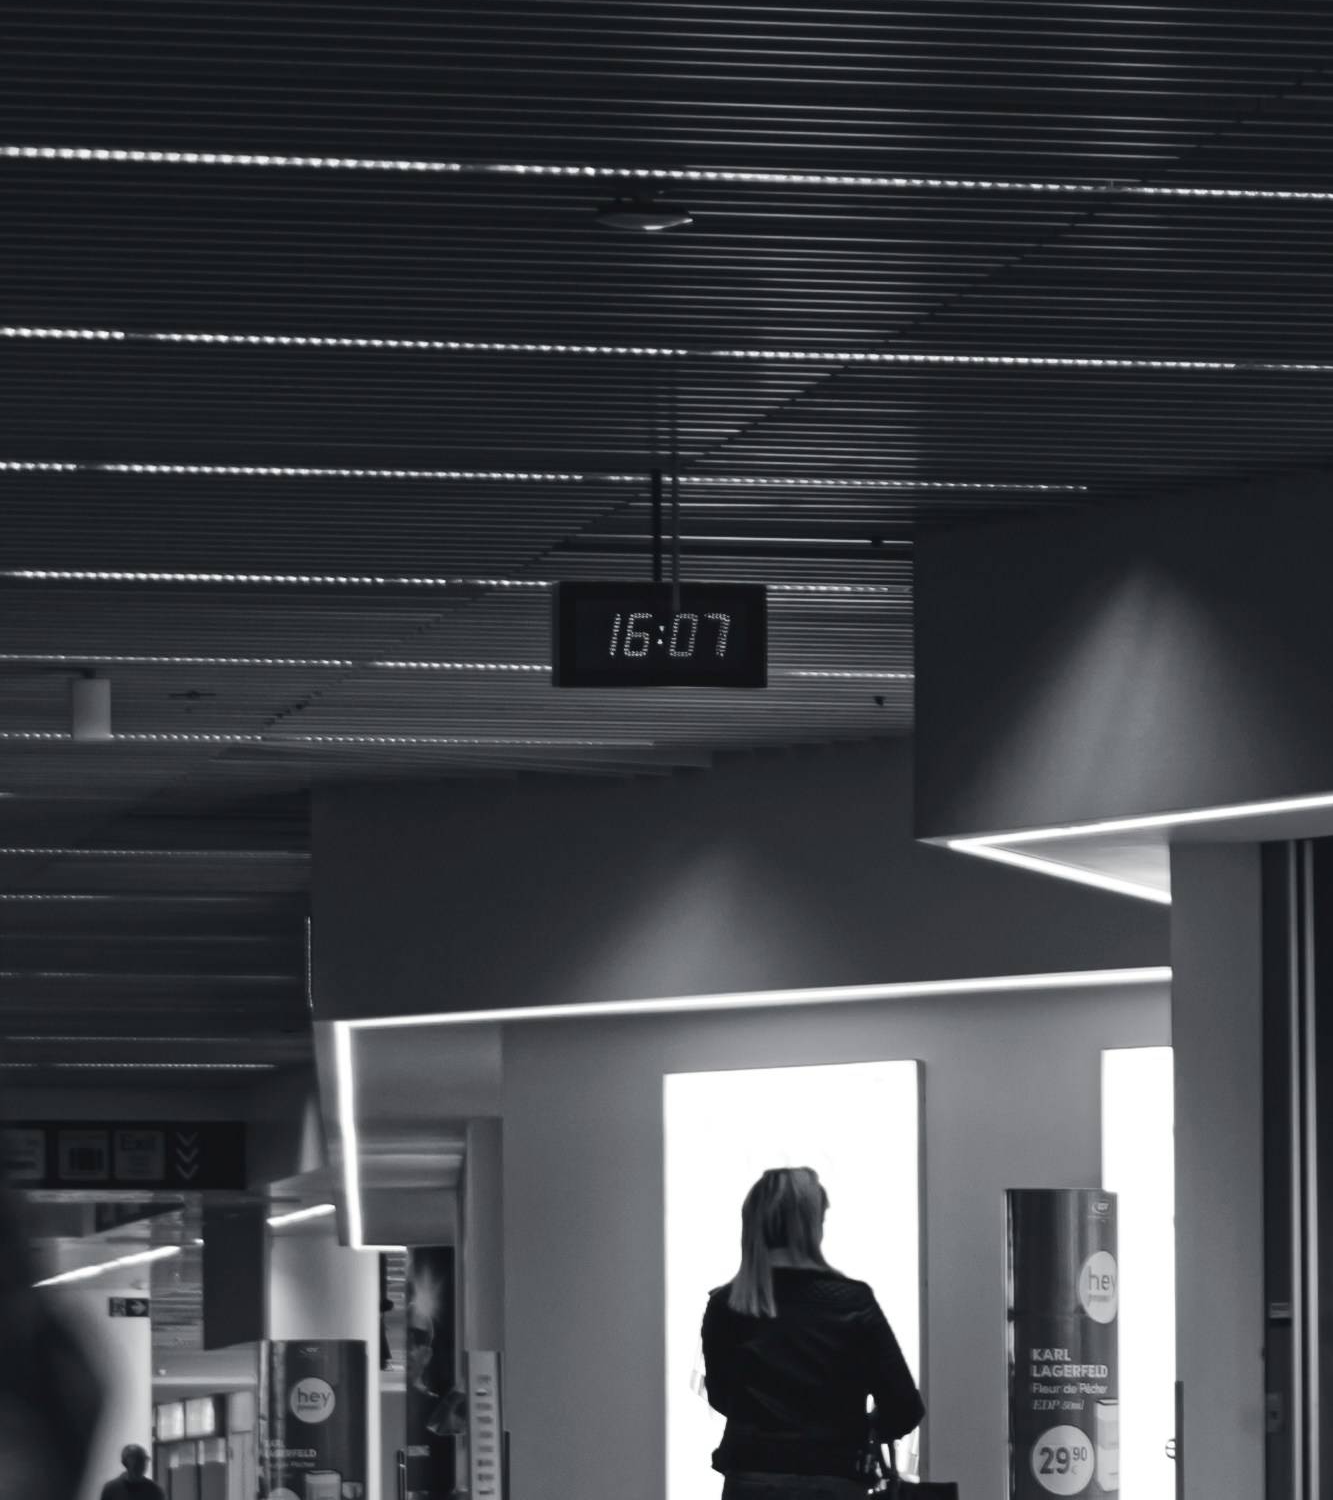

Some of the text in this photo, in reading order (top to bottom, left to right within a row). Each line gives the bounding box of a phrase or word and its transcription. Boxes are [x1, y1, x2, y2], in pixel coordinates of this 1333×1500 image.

[609, 612, 731, 657] 16:07
[1032, 1348, 1071, 1361] KARL
[1032, 1365, 1109, 1378] LAGERFELD
[1032, 1383, 1060, 1394] Fleur
[1063, 1383, 1077, 1394] de
[297, 1387, 331, 1407] hey
[1032, 1399, 1060, 1410] EDP
